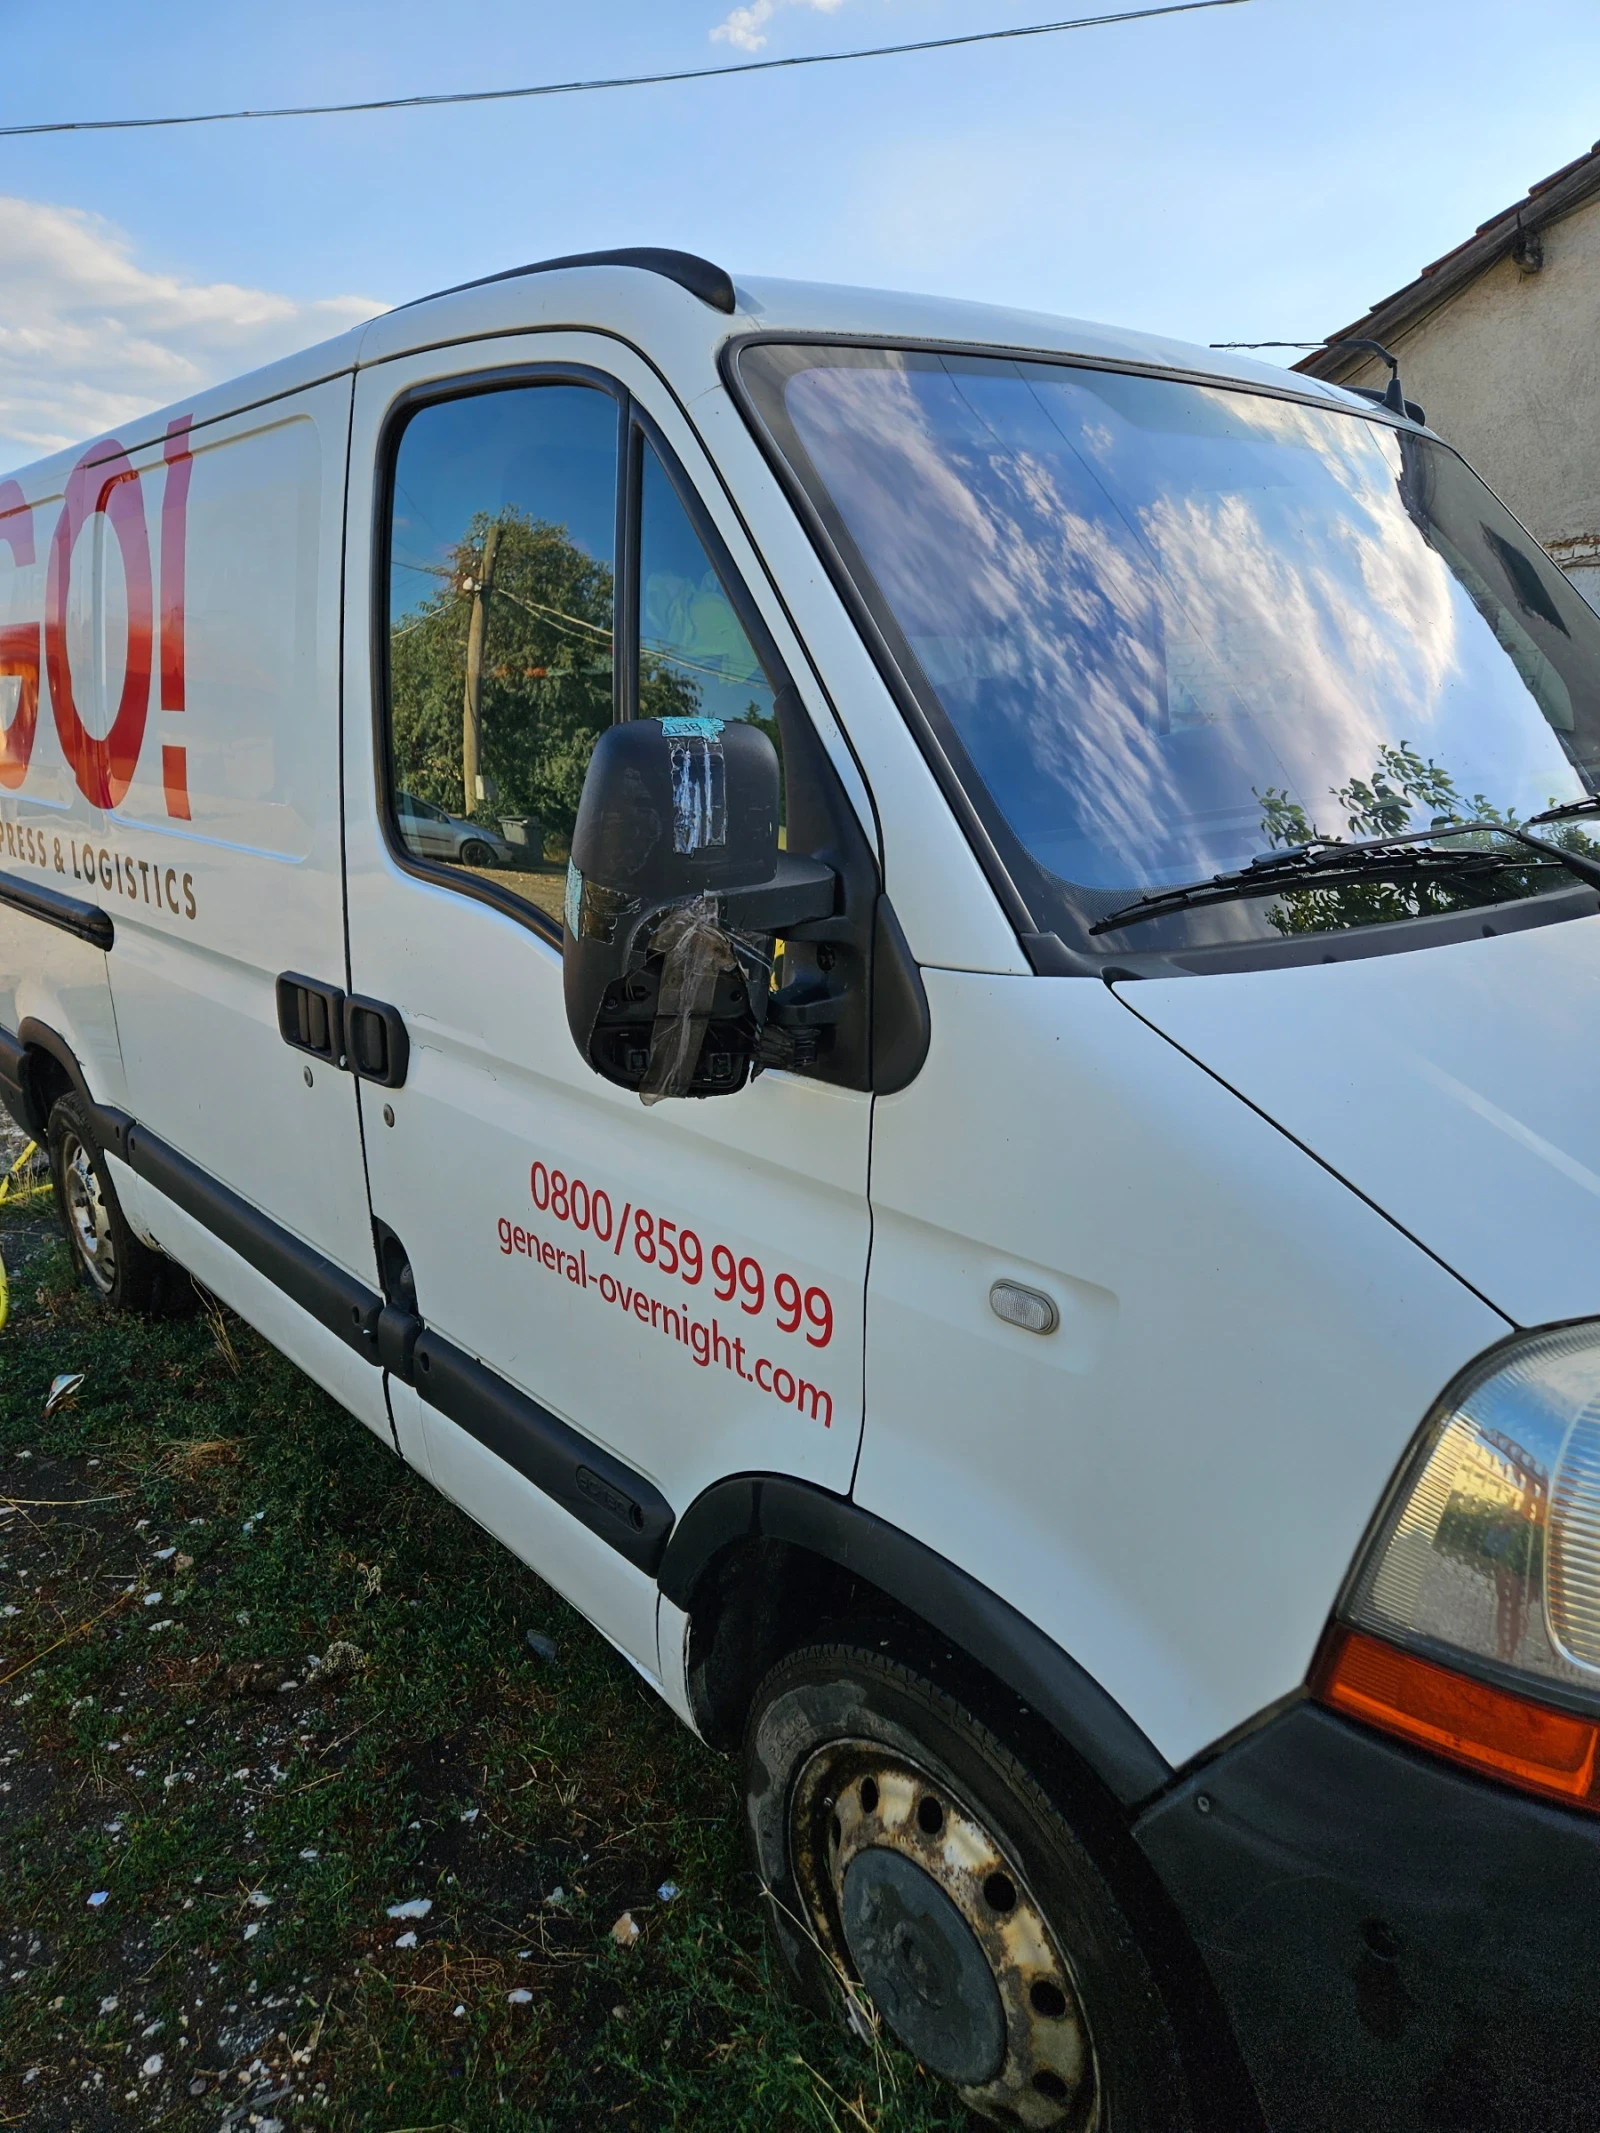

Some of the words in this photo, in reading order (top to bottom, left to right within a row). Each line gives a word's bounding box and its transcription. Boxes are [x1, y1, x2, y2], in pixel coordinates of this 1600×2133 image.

[54, 836, 66, 875] &
[70, 840, 197, 921] LOGISTICS
[498, 1217, 833, 1429] general-overnight.com
[531, 1161, 703, 1285] 0800/859
[711, 1244, 765, 1315] 99
[774, 1273, 833, 1348] 99
